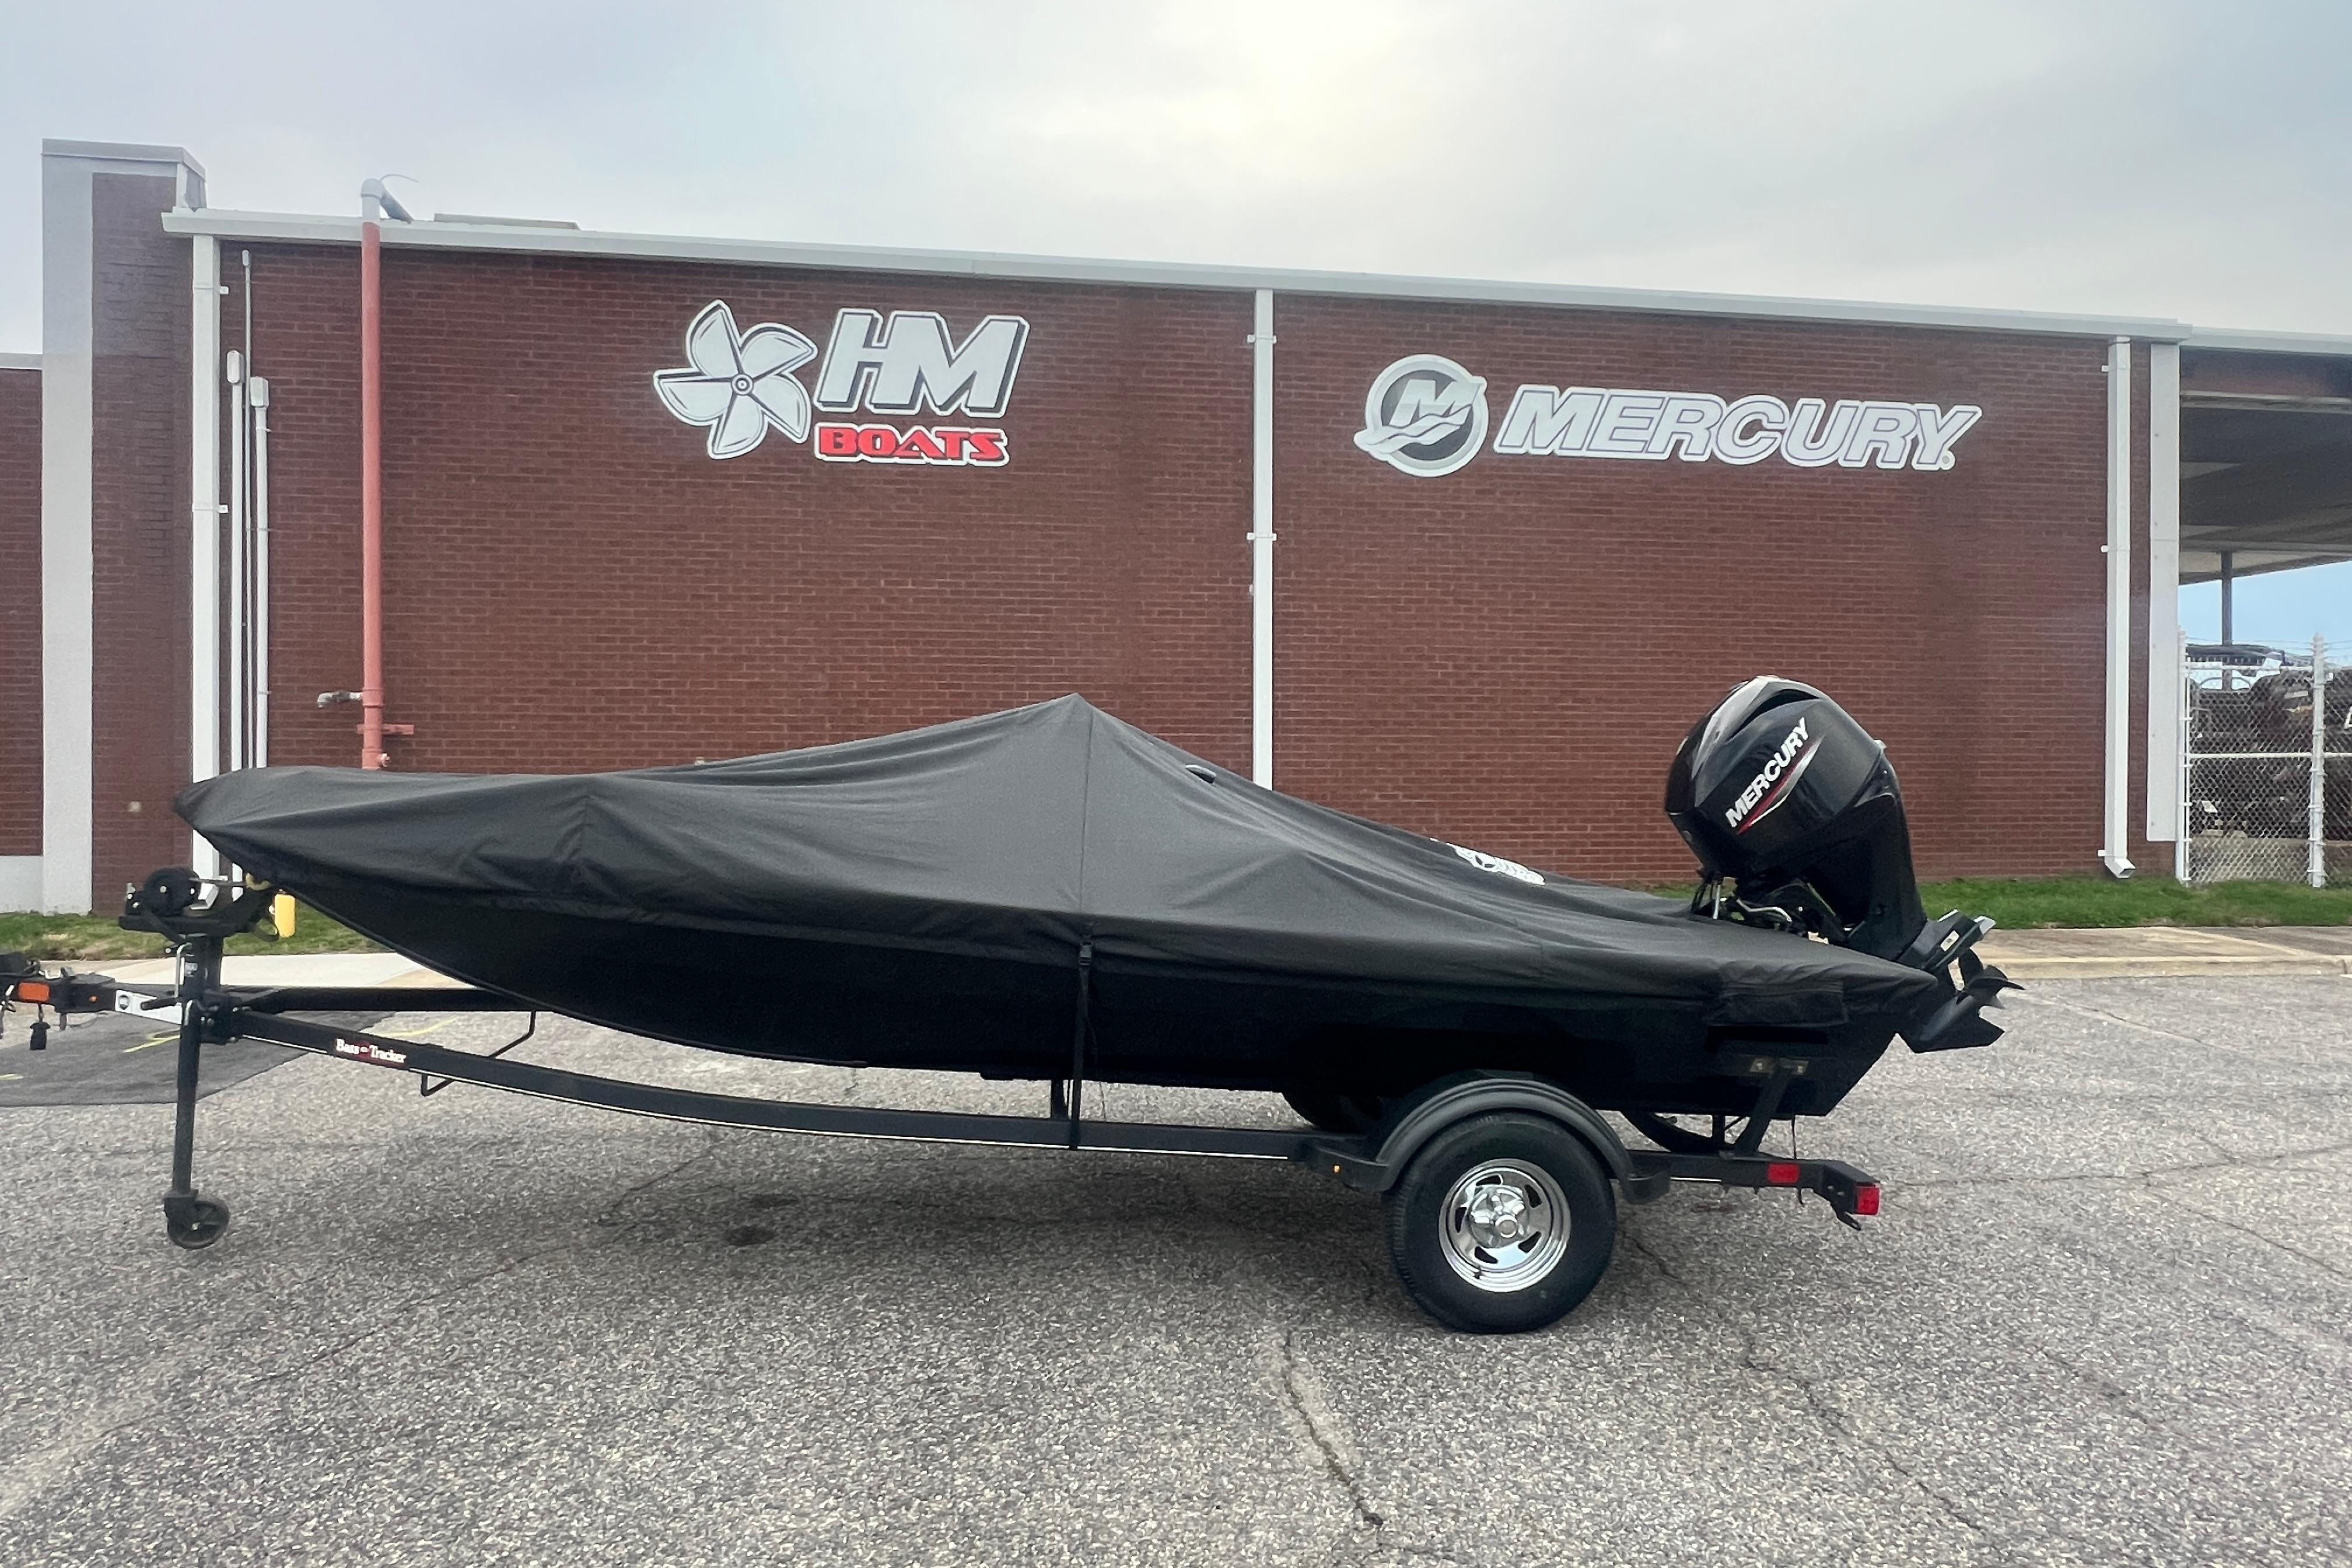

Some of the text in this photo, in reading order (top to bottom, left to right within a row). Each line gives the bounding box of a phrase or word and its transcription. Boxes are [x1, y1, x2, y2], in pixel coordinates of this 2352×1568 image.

[815, 309, 1028, 416] HM
[818, 425, 1006, 461] BOATS
[1494, 386, 1981, 469] MERCURY
[1726, 716, 1808, 827] MERCURY
